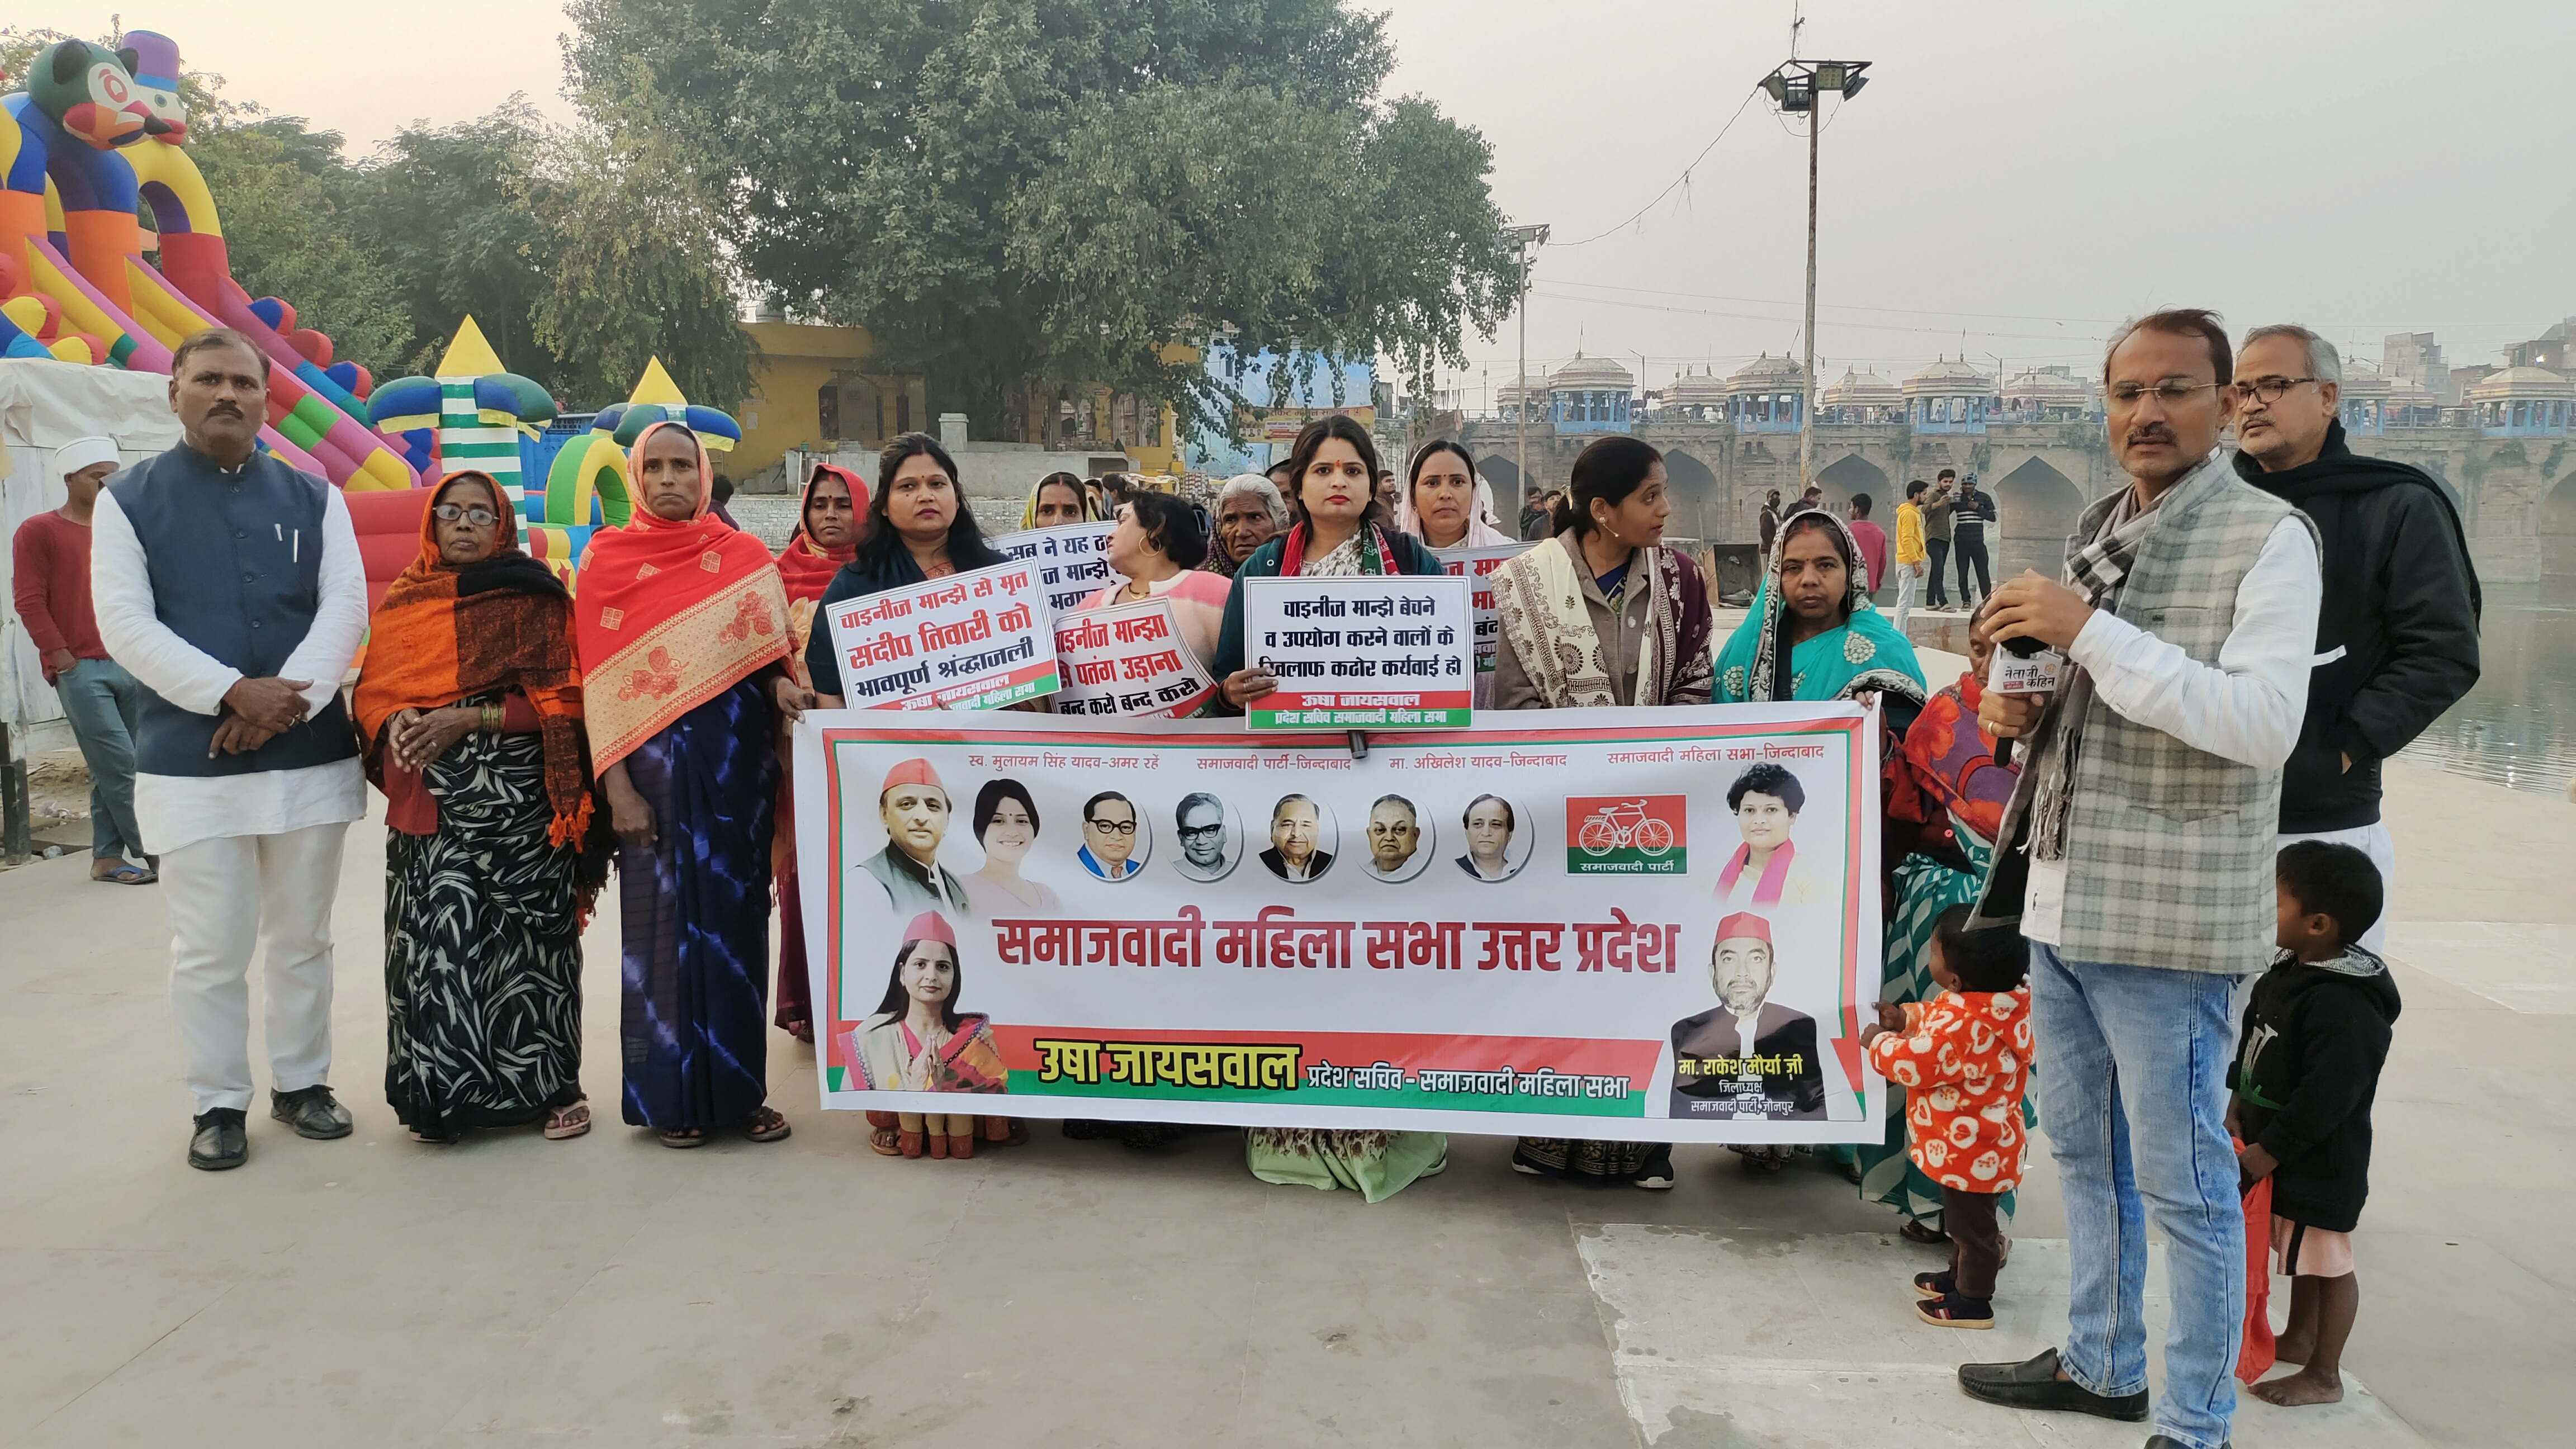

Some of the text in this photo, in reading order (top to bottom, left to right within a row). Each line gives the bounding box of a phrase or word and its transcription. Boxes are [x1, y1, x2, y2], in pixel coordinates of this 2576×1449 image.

[1042, 536, 1058, 557] ने
[1062, 536, 1089, 554] यह
[839, 598, 913, 629] चाइनीज
[916, 583, 968, 610] मान्झे
[971, 577, 993, 599] से
[997, 571, 1029, 596] मृत
[1283, 595, 1436, 619] चाइनीज मान्झे बेचने
[847, 602, 1033, 670] संदीप तिवारी को
[1112, 613, 1170, 643] मान्झा
[1264, 624, 1455, 648] व उपयोग करने वालों के
[1074, 655, 1118, 686] पतंग
[1119, 649, 1184, 684] उड़ाना
[1445, 655, 1462, 676] हो
[2005, 665, 2038, 679] नेताजी
[855, 660, 931, 697] भावपूर्ण
[2026, 674, 2055, 688] कहिन
[1088, 692, 1118, 716] करो
[1119, 691, 1154, 711] बन्द
[1154, 677, 1201, 703] करो
[1301, 694, 1420, 707] ऊषा जायसवाल
[1275, 708, 1447, 724] प्रदेश सचिव समाजवादी महिला सभा
[968, 755, 987, 767] स्व.
[992, 755, 1039, 771] मुलायम
[1043, 751, 1067, 768] सिंह
[1143, 754, 1160, 770] रहें
[1196, 754, 1259, 770] समाजवादी
[1389, 757, 1408, 769] मा.
[1414, 752, 1466, 769] अखिलेश
[1606, 747, 1674, 764] समाजवादी
[1679, 745, 1721, 762] महिला
[1579, 859, 1675, 872] समाजवादी पार्टी
[991, 905, 1682, 974] समाजवादी महिला सभा उत्तर प्रदेश
[1034, 1039, 1102, 1083] उषा
[1104, 1042, 1301, 1089] जायसवाल
[1306, 1060, 1350, 1089] प्रदेश
[1353, 1062, 1405, 1090] सचिव
[1418, 1067, 1514, 1095] समाजवादी
[1517, 1068, 1581, 1097] महिला
[1583, 1075, 1630, 1098] सभा
[1678, 1059, 1699, 1075] मा.
[1702, 1054, 1743, 1075] राकेश
[1744, 1053, 1782, 1075] मौर्या
[1718, 1079, 1763, 1093] जिलाध्यक्ष
[1690, 1098, 1737, 1113] समाजवादी
[1761, 1098, 1794, 1116] जौनपुर
